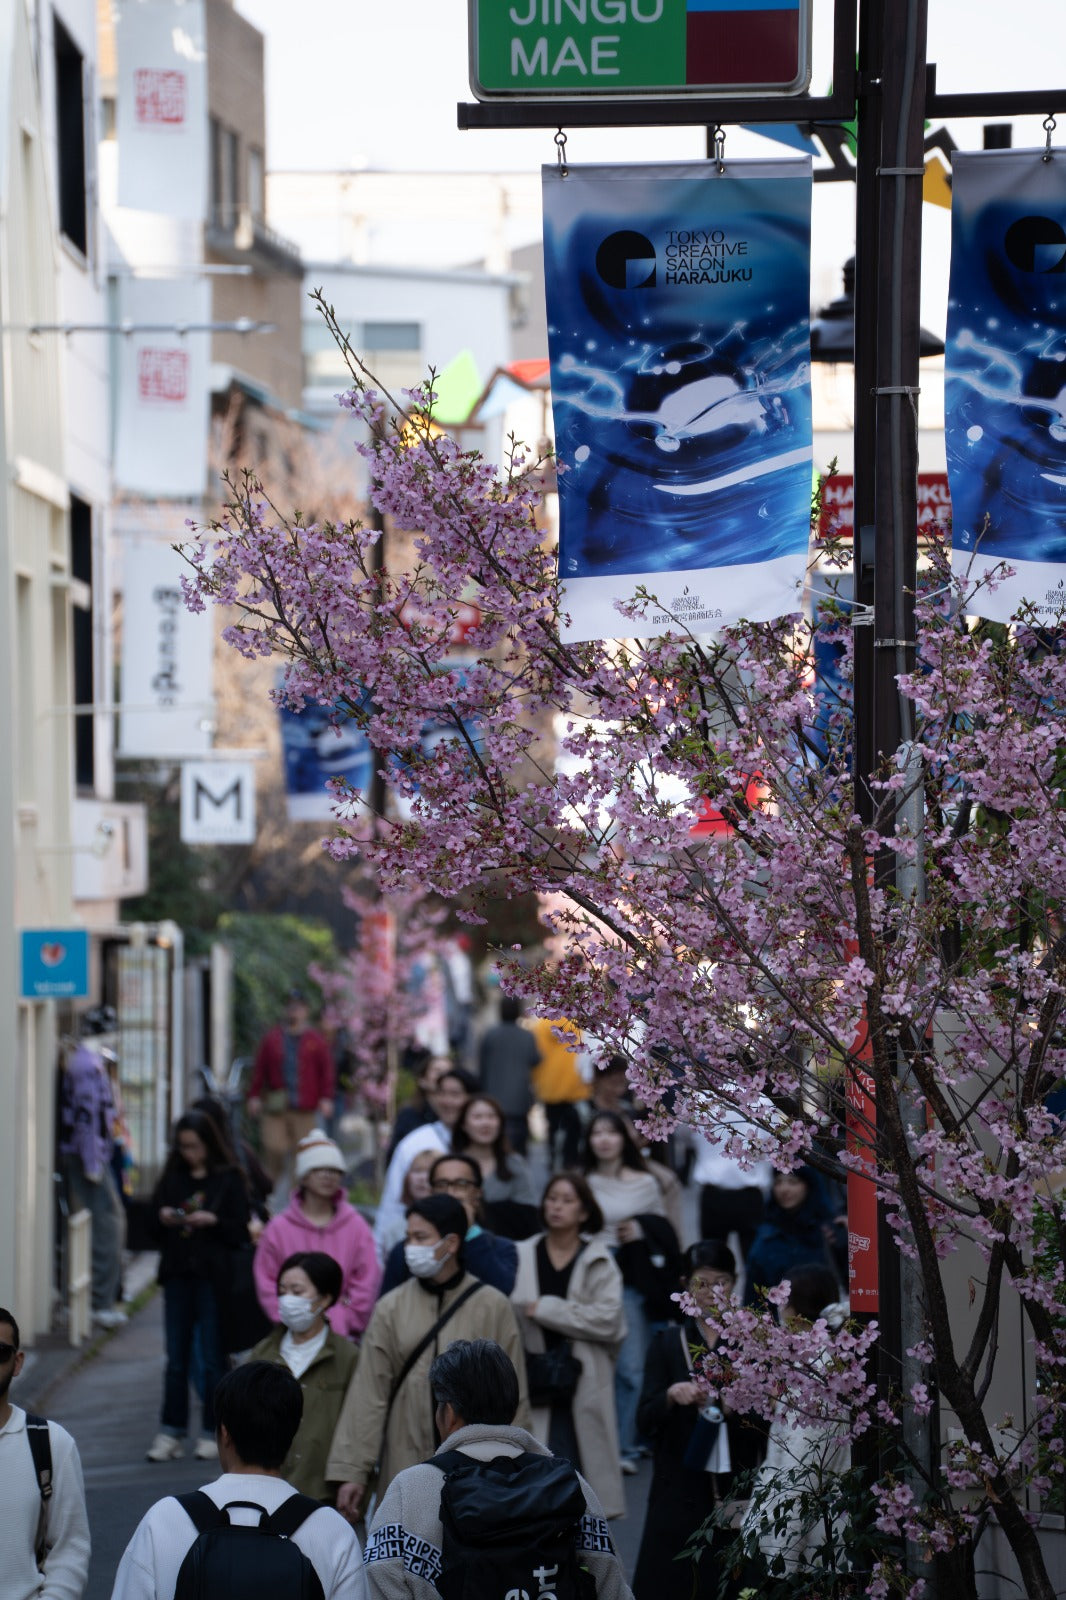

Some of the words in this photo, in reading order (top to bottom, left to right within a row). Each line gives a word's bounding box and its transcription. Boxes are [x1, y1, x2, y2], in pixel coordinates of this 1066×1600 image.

[509, 0, 664, 25] JINGU
[510, 35, 620, 76] MAE
[665, 230, 725, 244] TOKYO
[665, 241, 748, 258] CREATIVE
[666, 257, 725, 272] SALON
[665, 268, 753, 285] HARAJUKU
[193, 775, 242, 822] M
